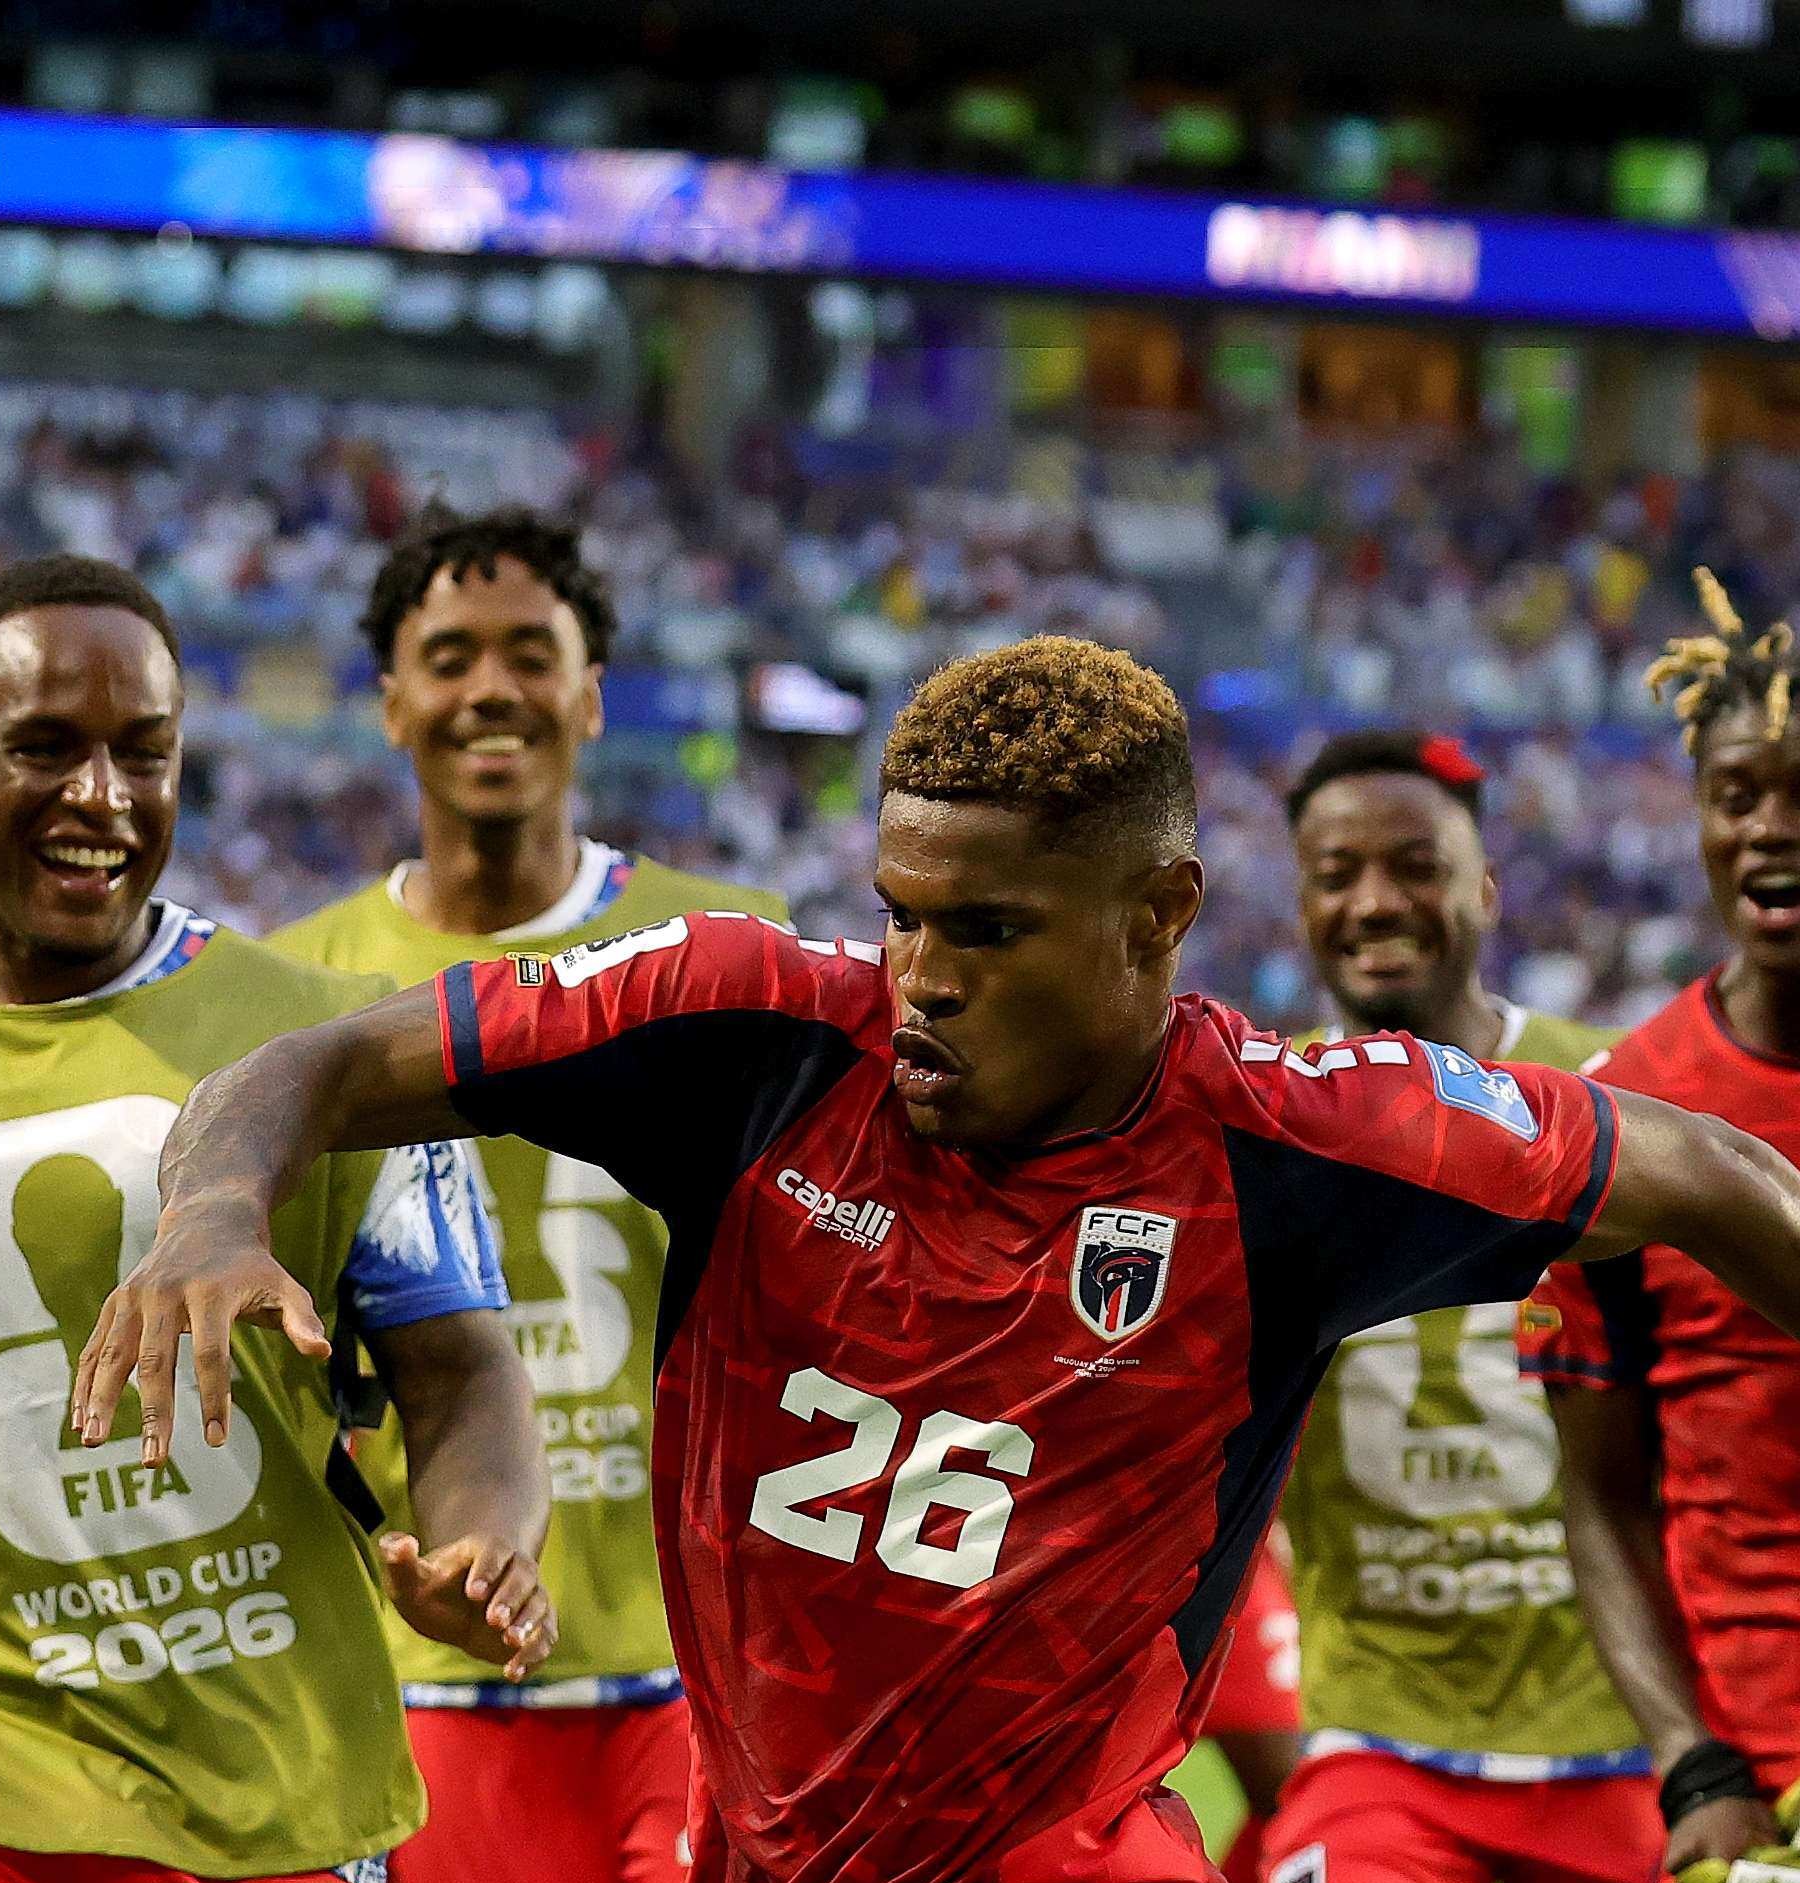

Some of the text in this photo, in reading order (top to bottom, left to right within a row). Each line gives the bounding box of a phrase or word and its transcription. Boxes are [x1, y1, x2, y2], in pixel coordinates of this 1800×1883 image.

[776, 1168, 896, 1243] capelli
[813, 1216, 881, 1252] SPORT
[1087, 1212, 1169, 1237] FCF
[61, 1458, 192, 1518] FIFA
[749, 1366, 1035, 1590] 26
[12, 1541, 282, 1629] WORLD CUP
[29, 1591, 297, 1690] 2026
